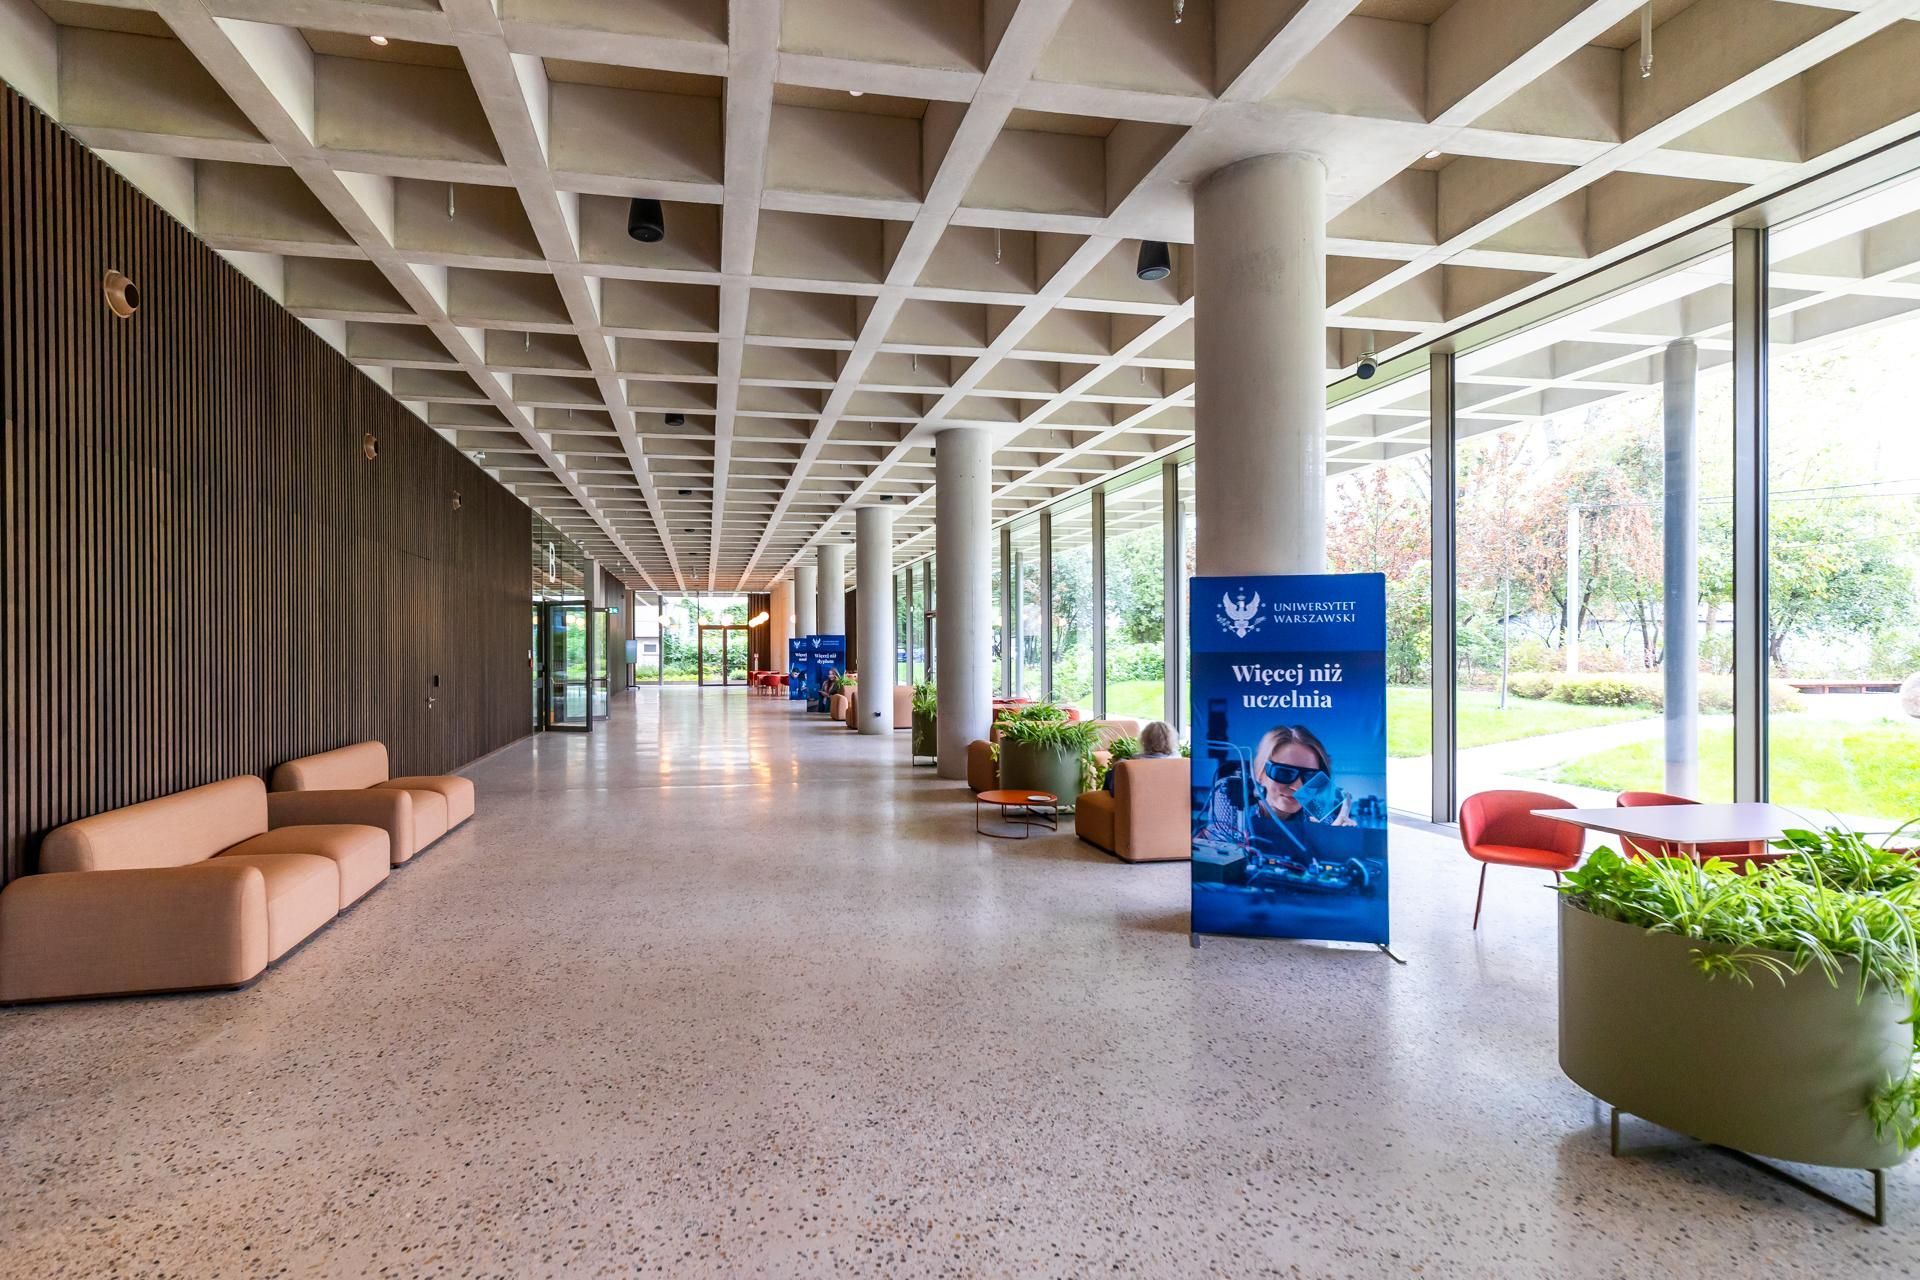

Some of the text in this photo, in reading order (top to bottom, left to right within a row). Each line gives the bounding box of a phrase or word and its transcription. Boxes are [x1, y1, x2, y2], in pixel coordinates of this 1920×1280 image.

[549, 541, 556, 583] B
[1273, 601, 1356, 612] UNIWERSYTET
[1273, 613, 1355, 623] WARSZAWSKI
[1232, 663, 1343, 685] Więcej niż
[1242, 689, 1332, 708] uczelnia
